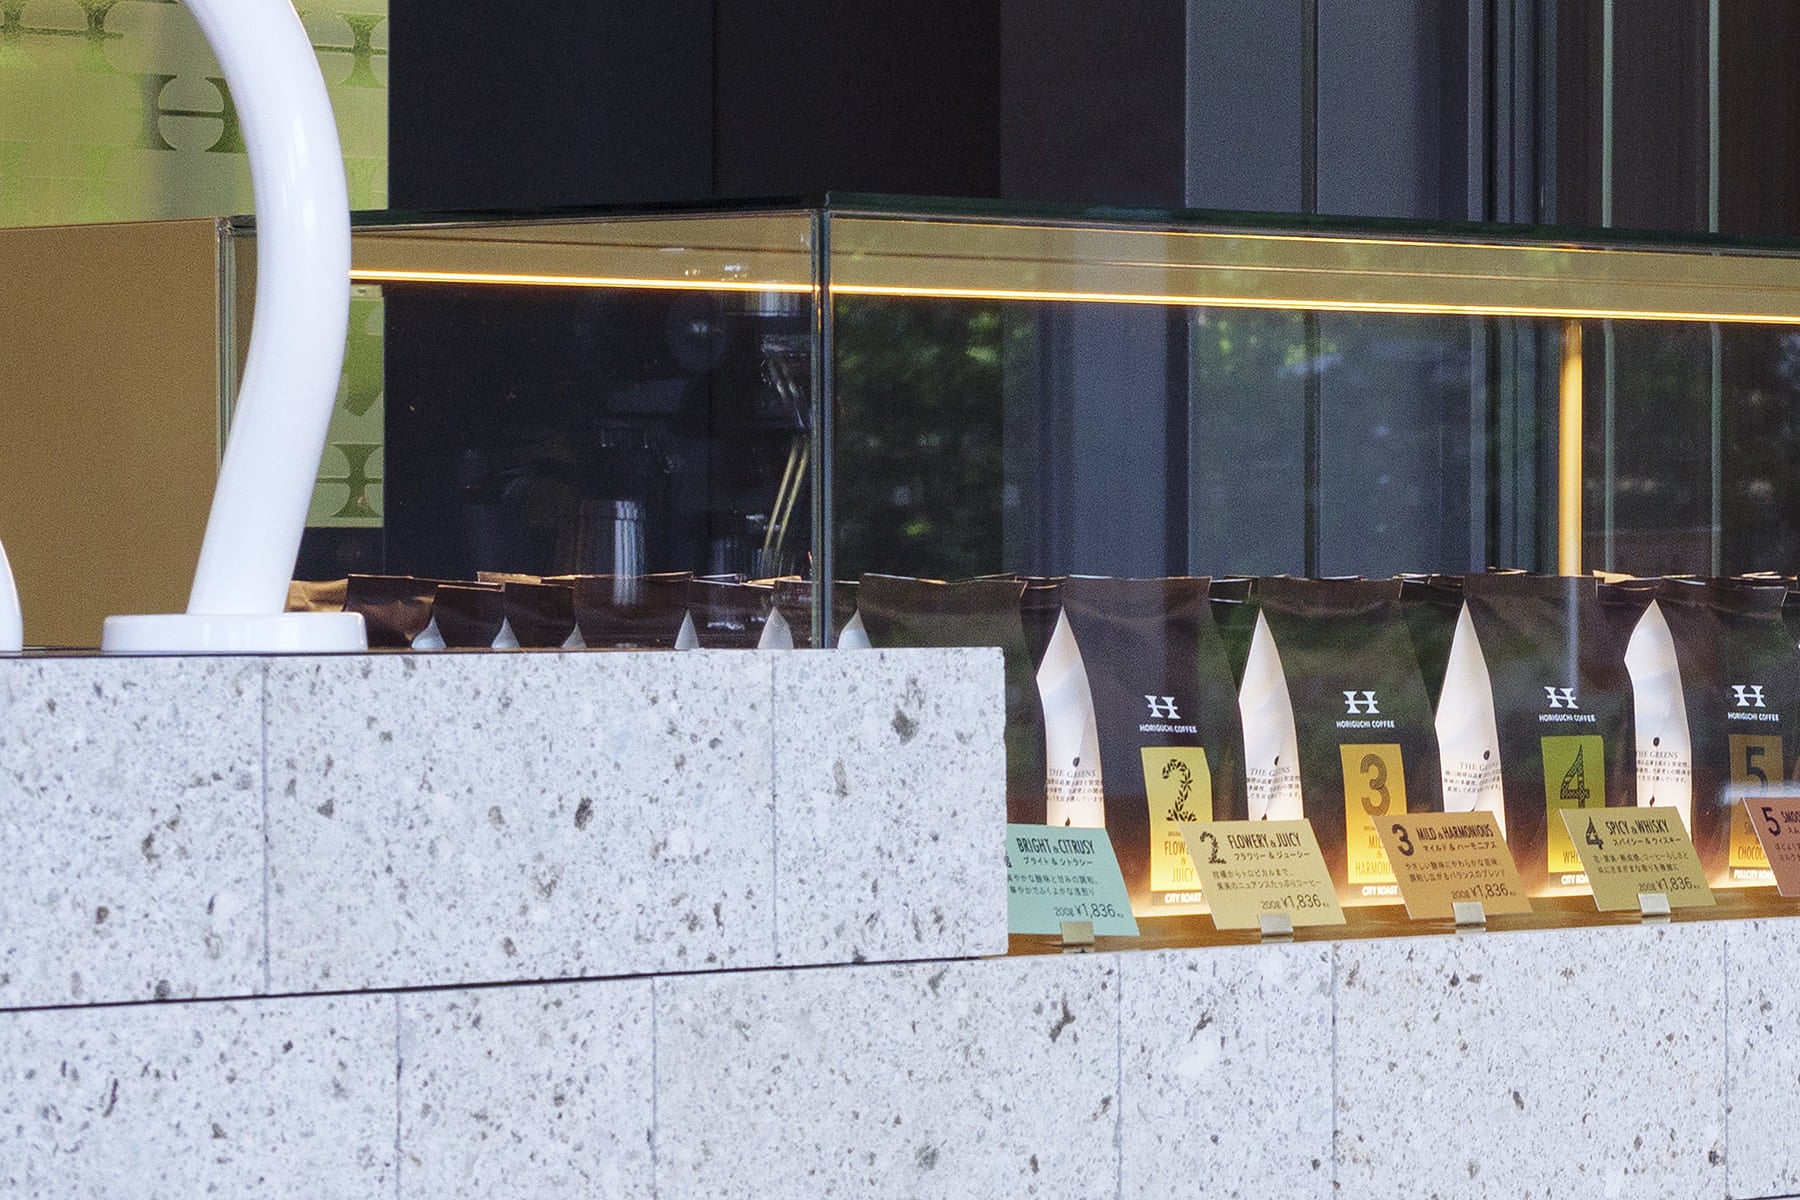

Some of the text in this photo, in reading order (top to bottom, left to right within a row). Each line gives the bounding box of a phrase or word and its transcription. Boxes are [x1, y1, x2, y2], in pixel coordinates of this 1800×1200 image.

[1539, 714, 1596, 722] HORIGUCHI COFFEE
[1727, 712, 1757, 721] HORIGUCHI
[1360, 754, 1390, 816] 3
[1560, 744, 1590, 809] 4
[1162, 759, 1197, 822] 2
[1605, 821, 1630, 835] SPICY
[1636, 819, 1669, 834] WHISKY
[1761, 807, 1781, 837] 5
[1392, 823, 1414, 856] 3
[1416, 828, 1436, 840] MILD
[1442, 824, 1494, 838] HARMONIOUS
[1586, 816, 1604, 850] 4
[1016, 838, 1050, 852] BRIGHT
[1058, 839, 1095, 855] CITRUSY
[1200, 831, 1227, 864] 2
[1228, 834, 1268, 849] FLOWERY
[1275, 833, 1302, 847] JUICY
[1471, 883, 1509, 900] ¥1,836
[1658, 876, 1692, 892] ¥1,836
[1076, 903, 1116, 918] ¥1,836
[1282, 894, 1322, 912] ¥1,836
